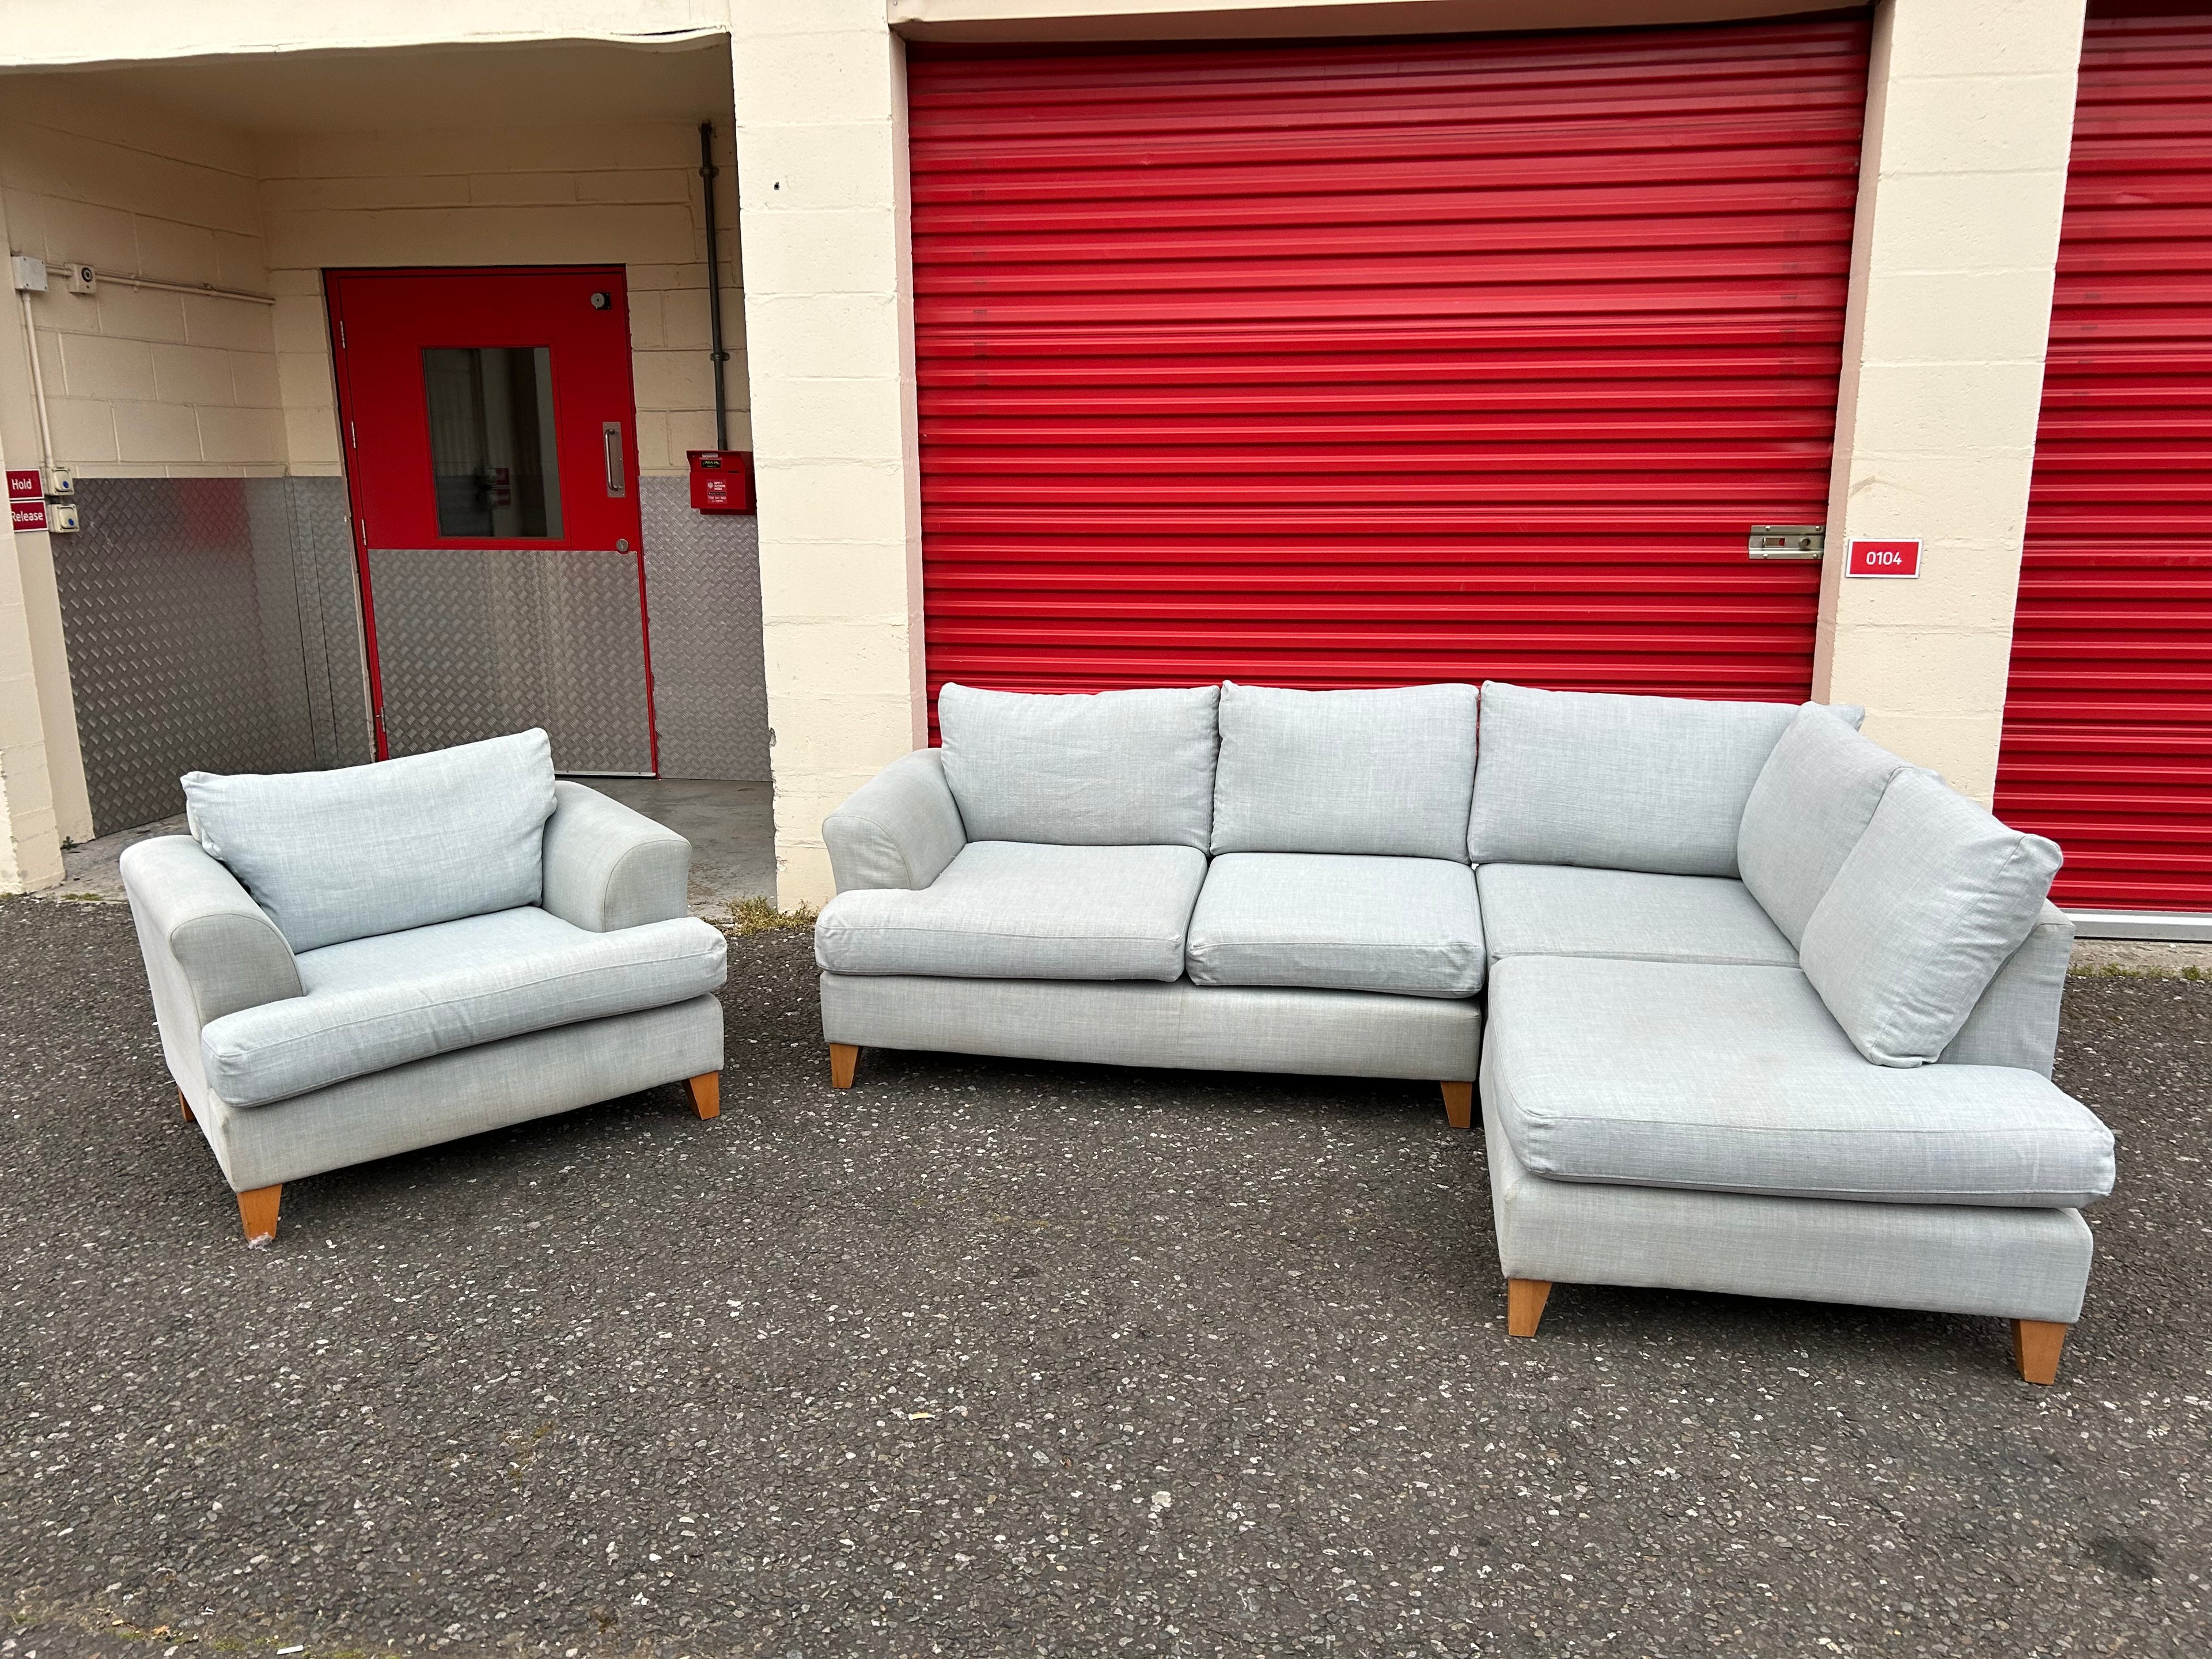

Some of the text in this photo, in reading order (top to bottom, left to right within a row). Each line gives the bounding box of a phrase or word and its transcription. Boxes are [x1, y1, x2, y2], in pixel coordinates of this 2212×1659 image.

[12, 478, 32, 490] Hold
[12, 510, 43, 521] Release
[1866, 551, 1902, 565] 0104
